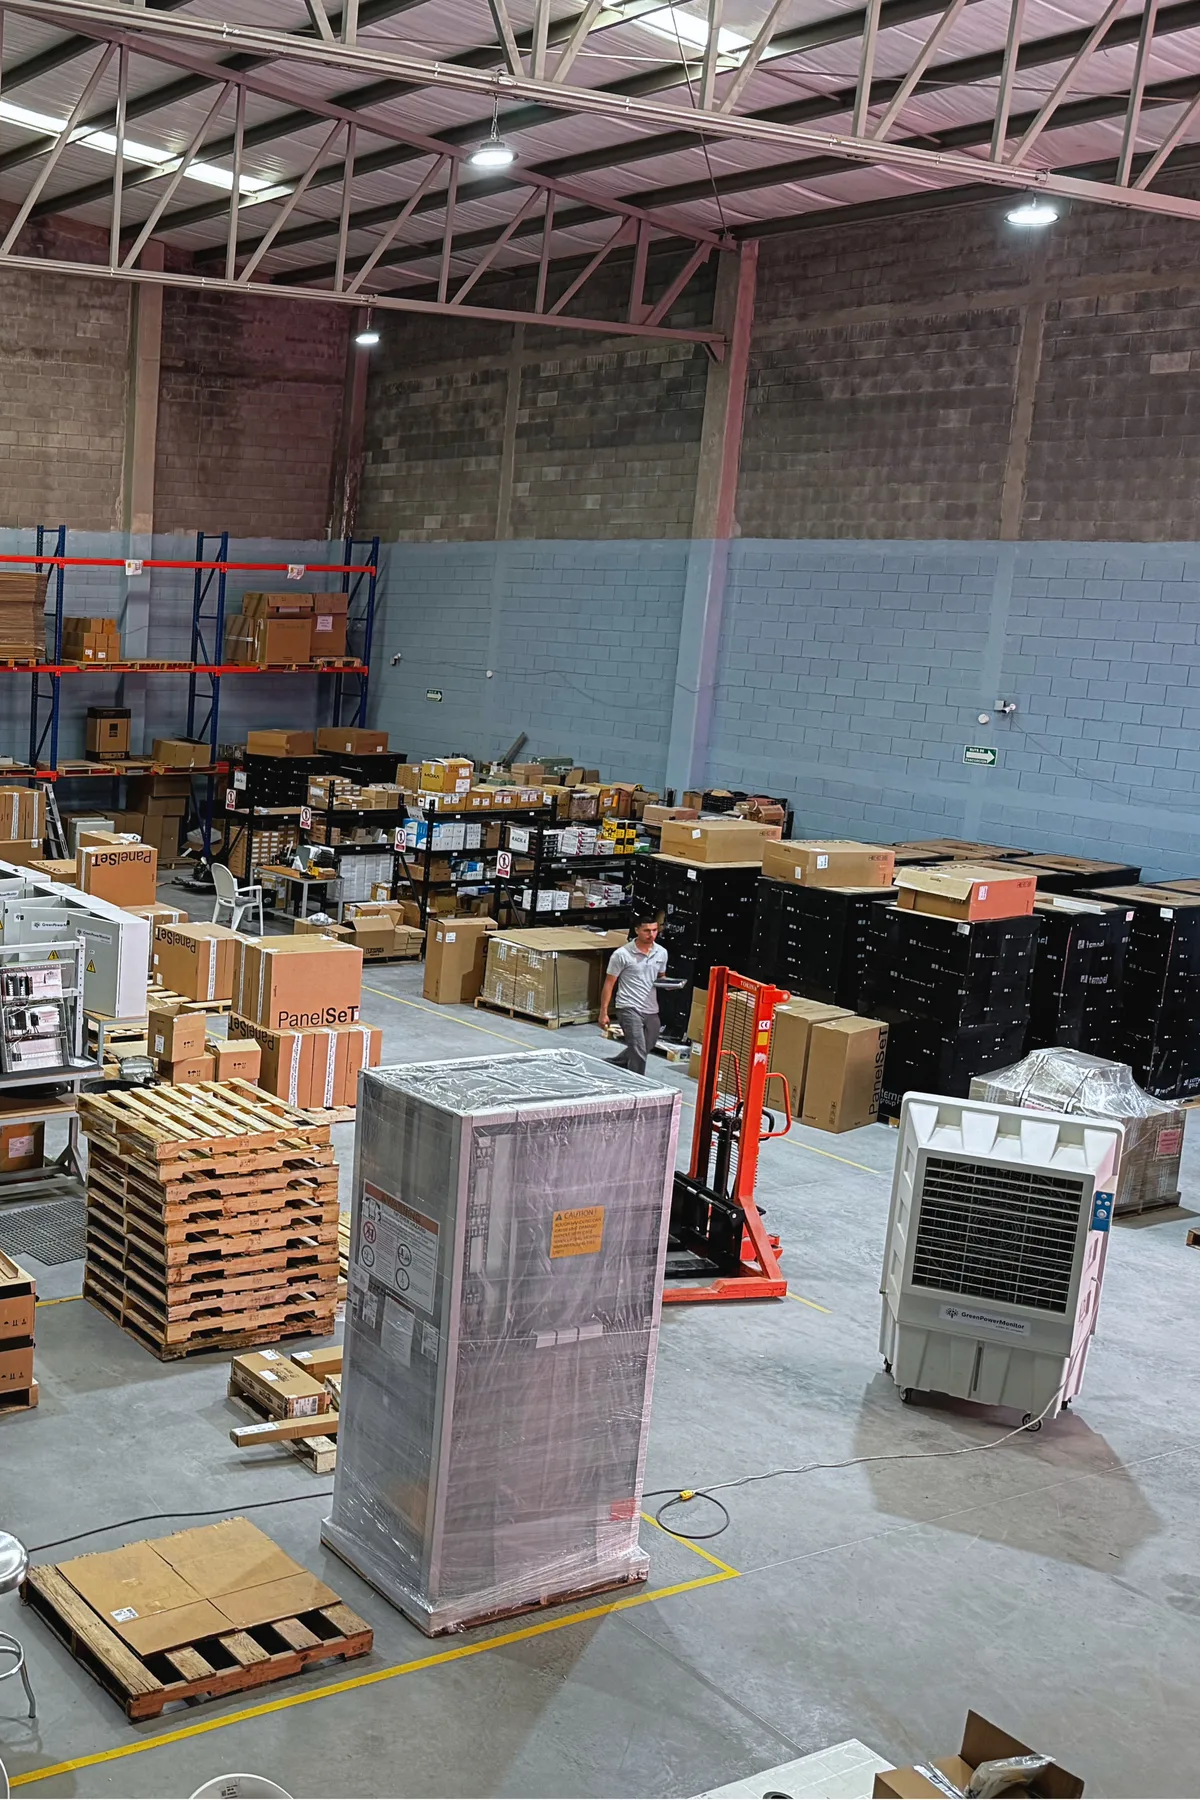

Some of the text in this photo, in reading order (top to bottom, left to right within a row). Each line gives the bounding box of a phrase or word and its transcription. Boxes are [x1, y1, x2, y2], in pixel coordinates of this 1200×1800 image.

[92, 851, 152, 867] PanelSeT
[155, 927, 197, 954] PanelSeT
[278, 1005, 359, 1029] PanelSeT
[228, 1014, 275, 1051] PanelSeT
[869, 1027, 888, 1116] PanelSeT
[961, 1311, 1026, 1330] GreenPowerMonitor
